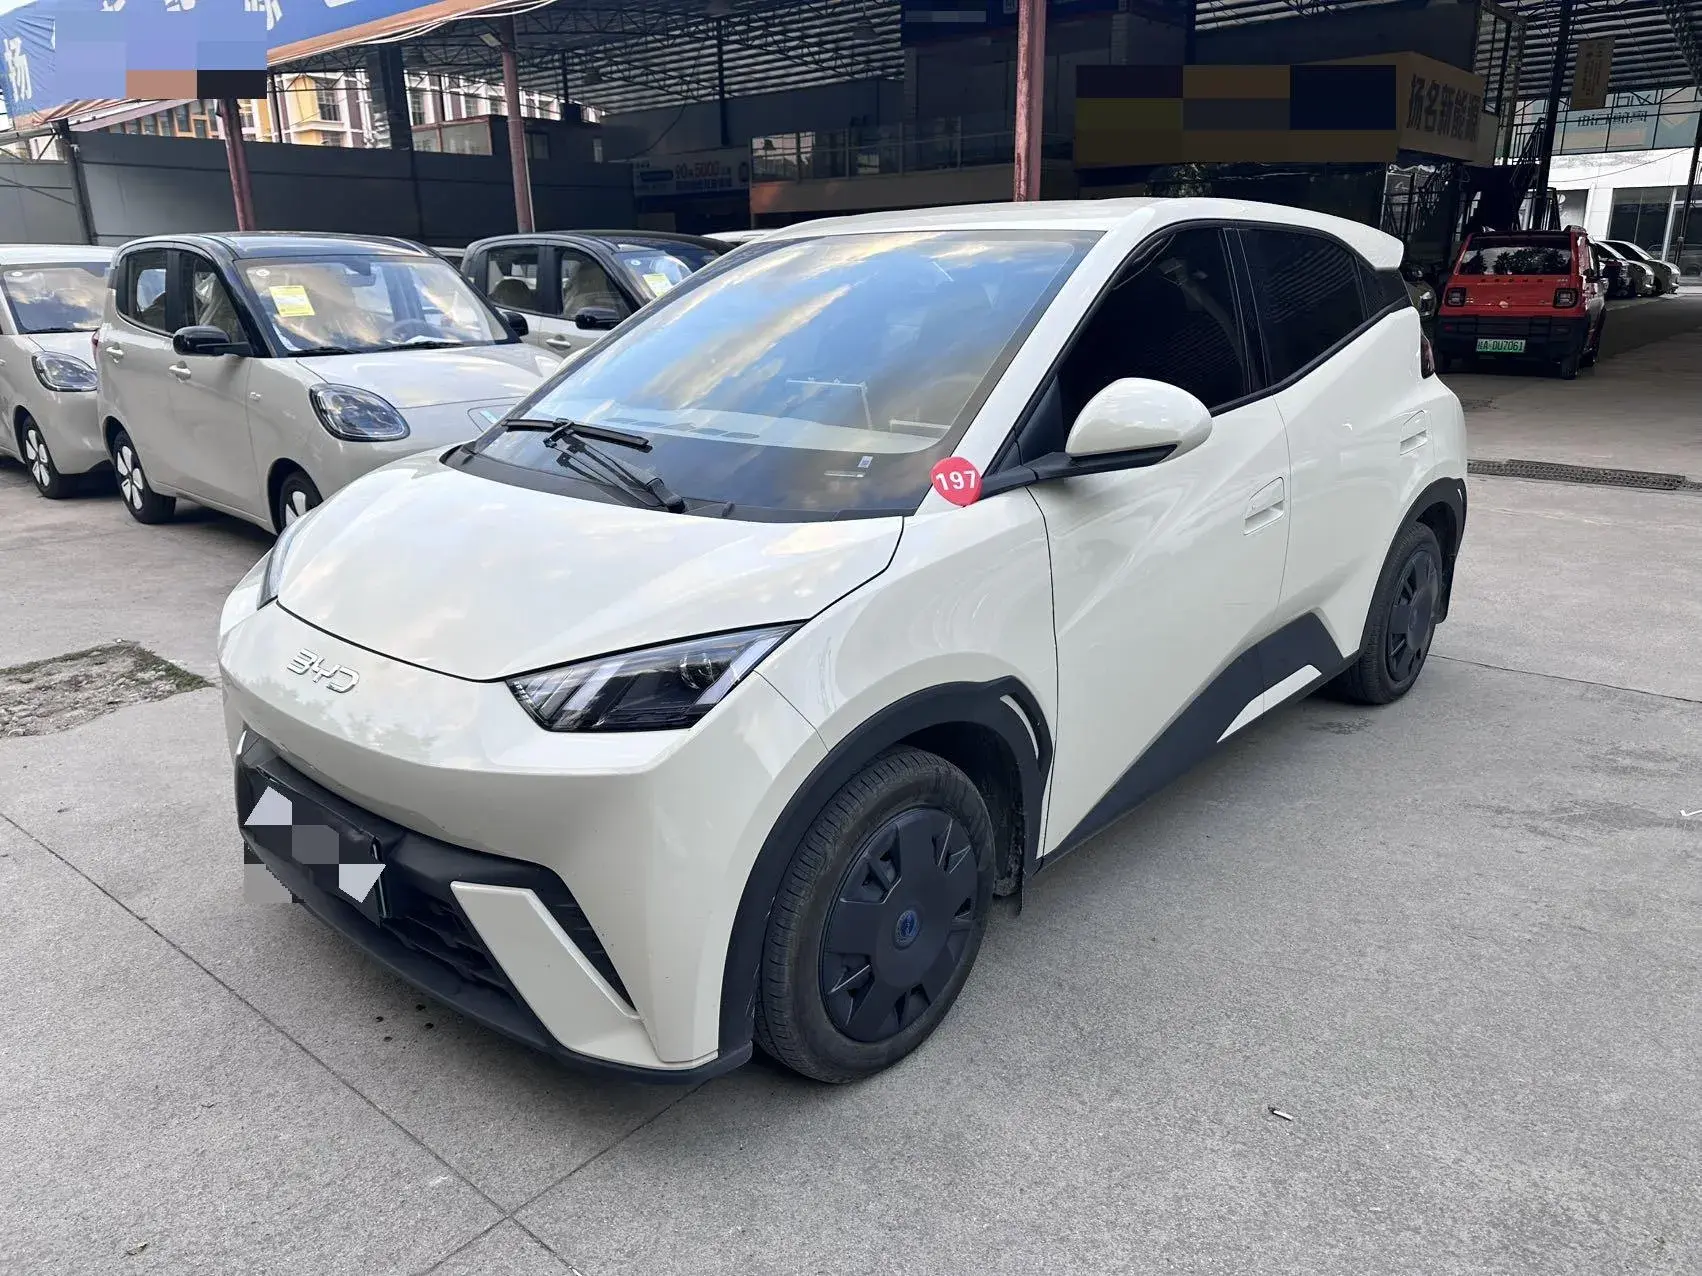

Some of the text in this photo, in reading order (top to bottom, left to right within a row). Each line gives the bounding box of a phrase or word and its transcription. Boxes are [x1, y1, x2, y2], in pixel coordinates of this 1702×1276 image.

[1406, 73, 1481, 143] 扬名新能源
[935, 469, 976, 491] 197
[286, 647, 360, 694] BYD
